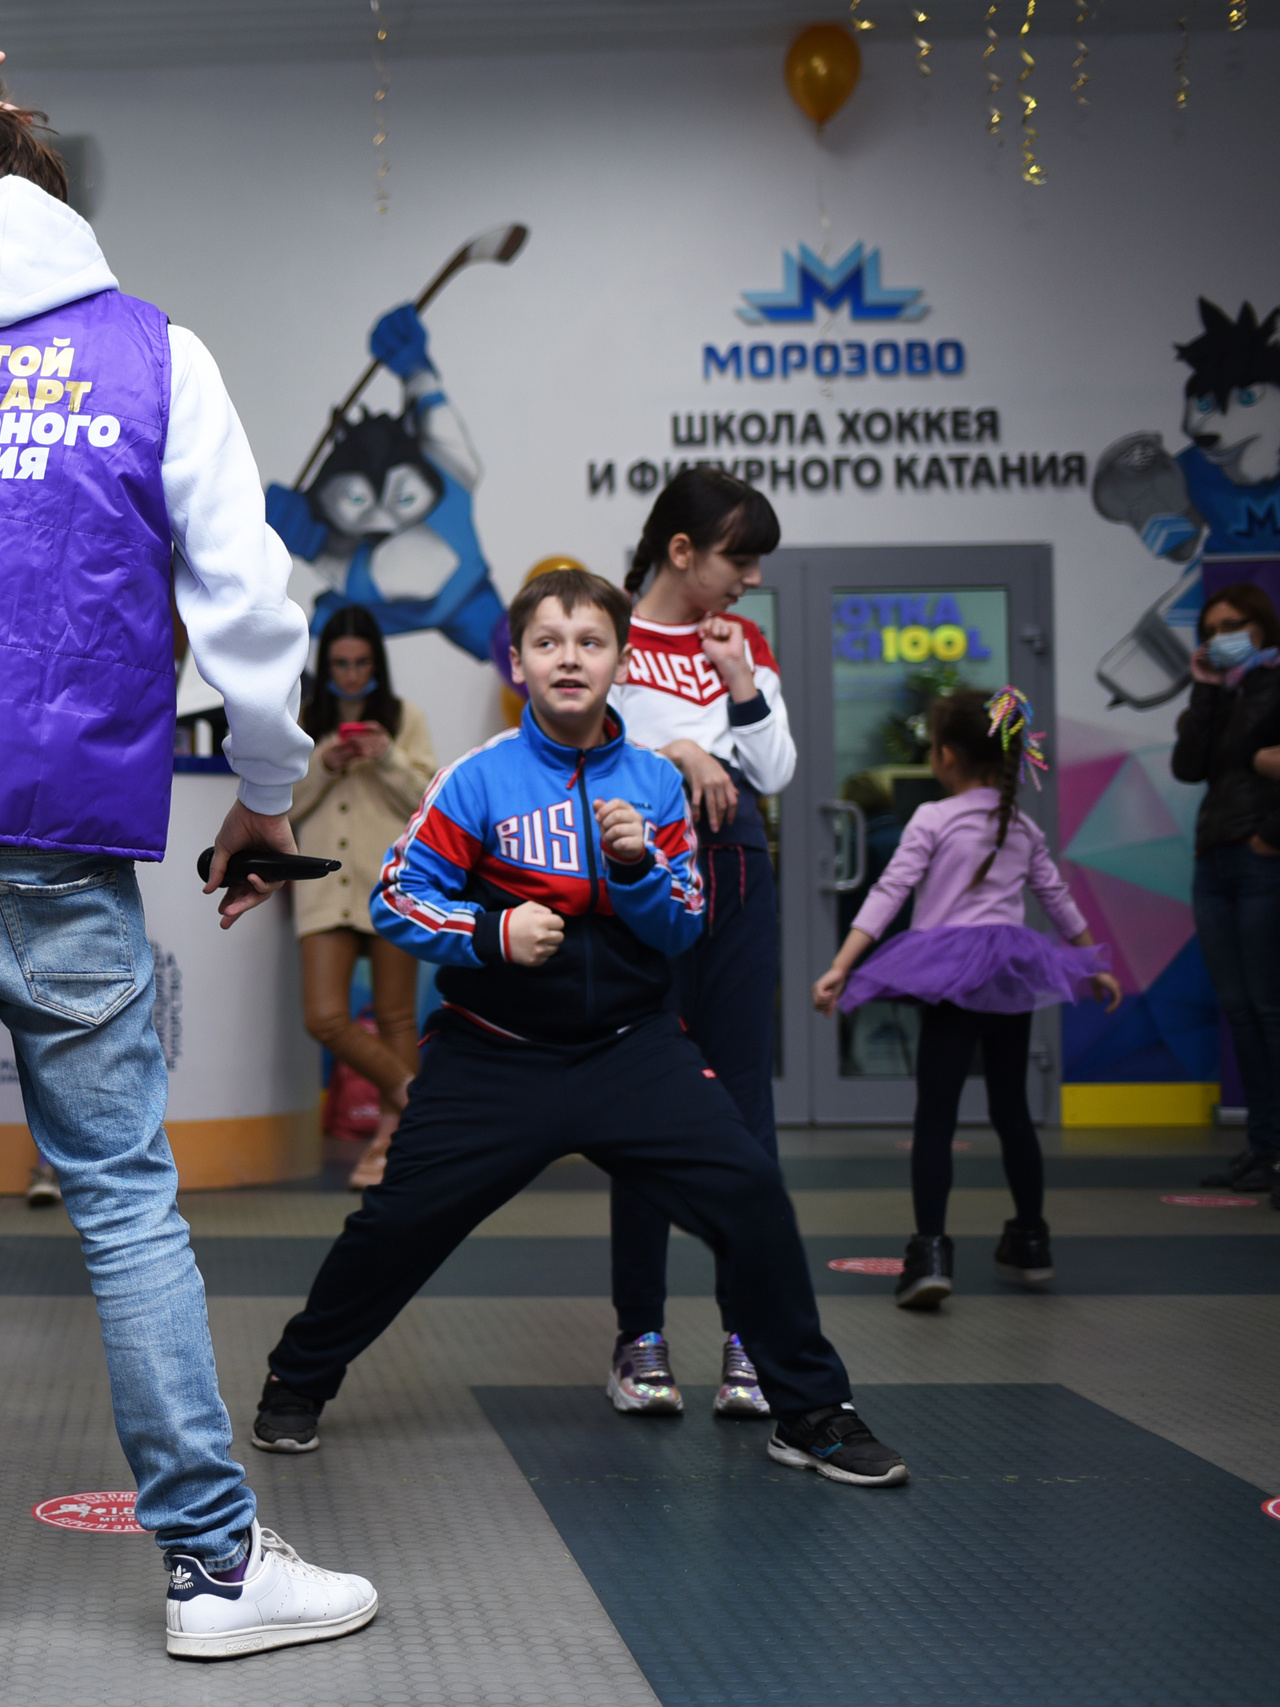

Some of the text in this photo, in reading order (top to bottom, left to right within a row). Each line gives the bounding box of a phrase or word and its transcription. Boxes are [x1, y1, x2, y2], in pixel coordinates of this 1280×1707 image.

[703, 340, 966, 379] МОРОЗОВО
[672, 408, 1000, 447] ШКОЛА ХОККЕЯ
[588, 453, 1087, 496] И ФИУРНОГО КАТАНИЯ
[832, 594, 963, 629] ОТКА
[628, 648, 723, 701] RUSS
[174, 1580, 194, 1590] smith
